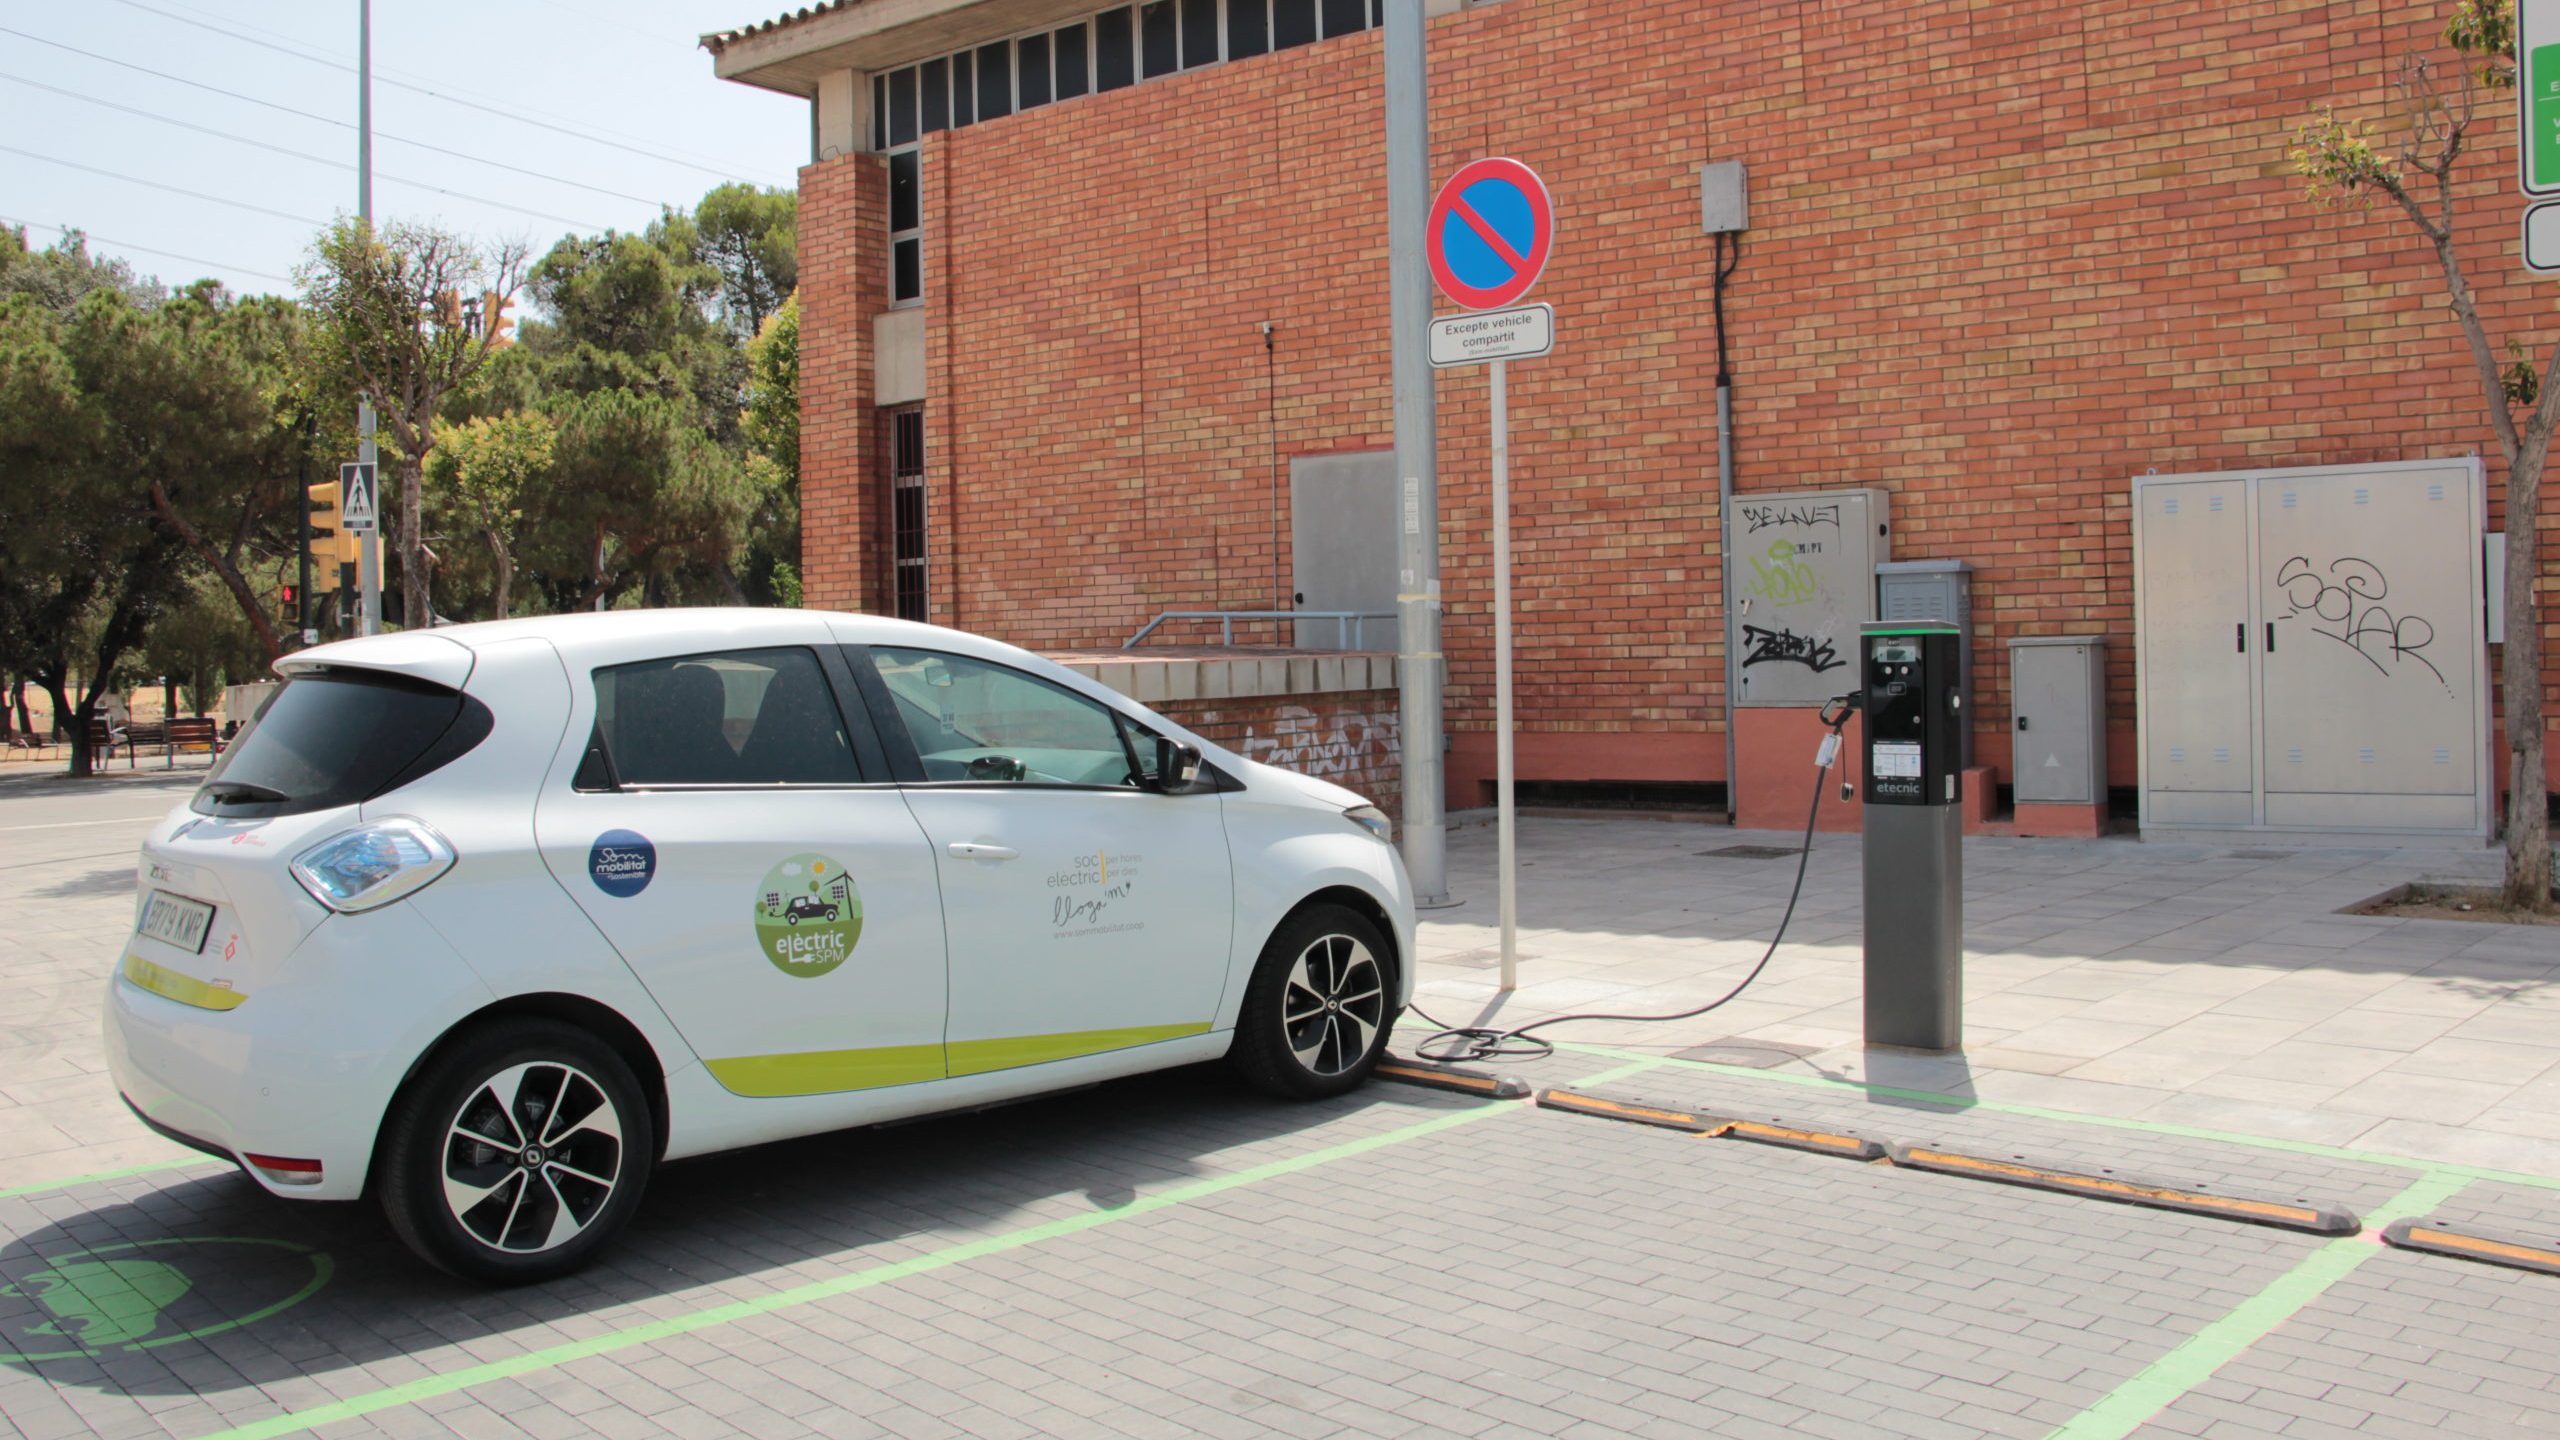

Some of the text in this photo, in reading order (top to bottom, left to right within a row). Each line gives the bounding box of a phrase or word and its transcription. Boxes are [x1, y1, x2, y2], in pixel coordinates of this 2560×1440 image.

[1445, 314, 1532, 336] Excepte vehicle
[1462, 331, 1516, 348] compartit
[1876, 782, 1920, 794] etecnic
[596, 860, 646, 873] mobilitat
[816, 948, 844, 963] SPM
